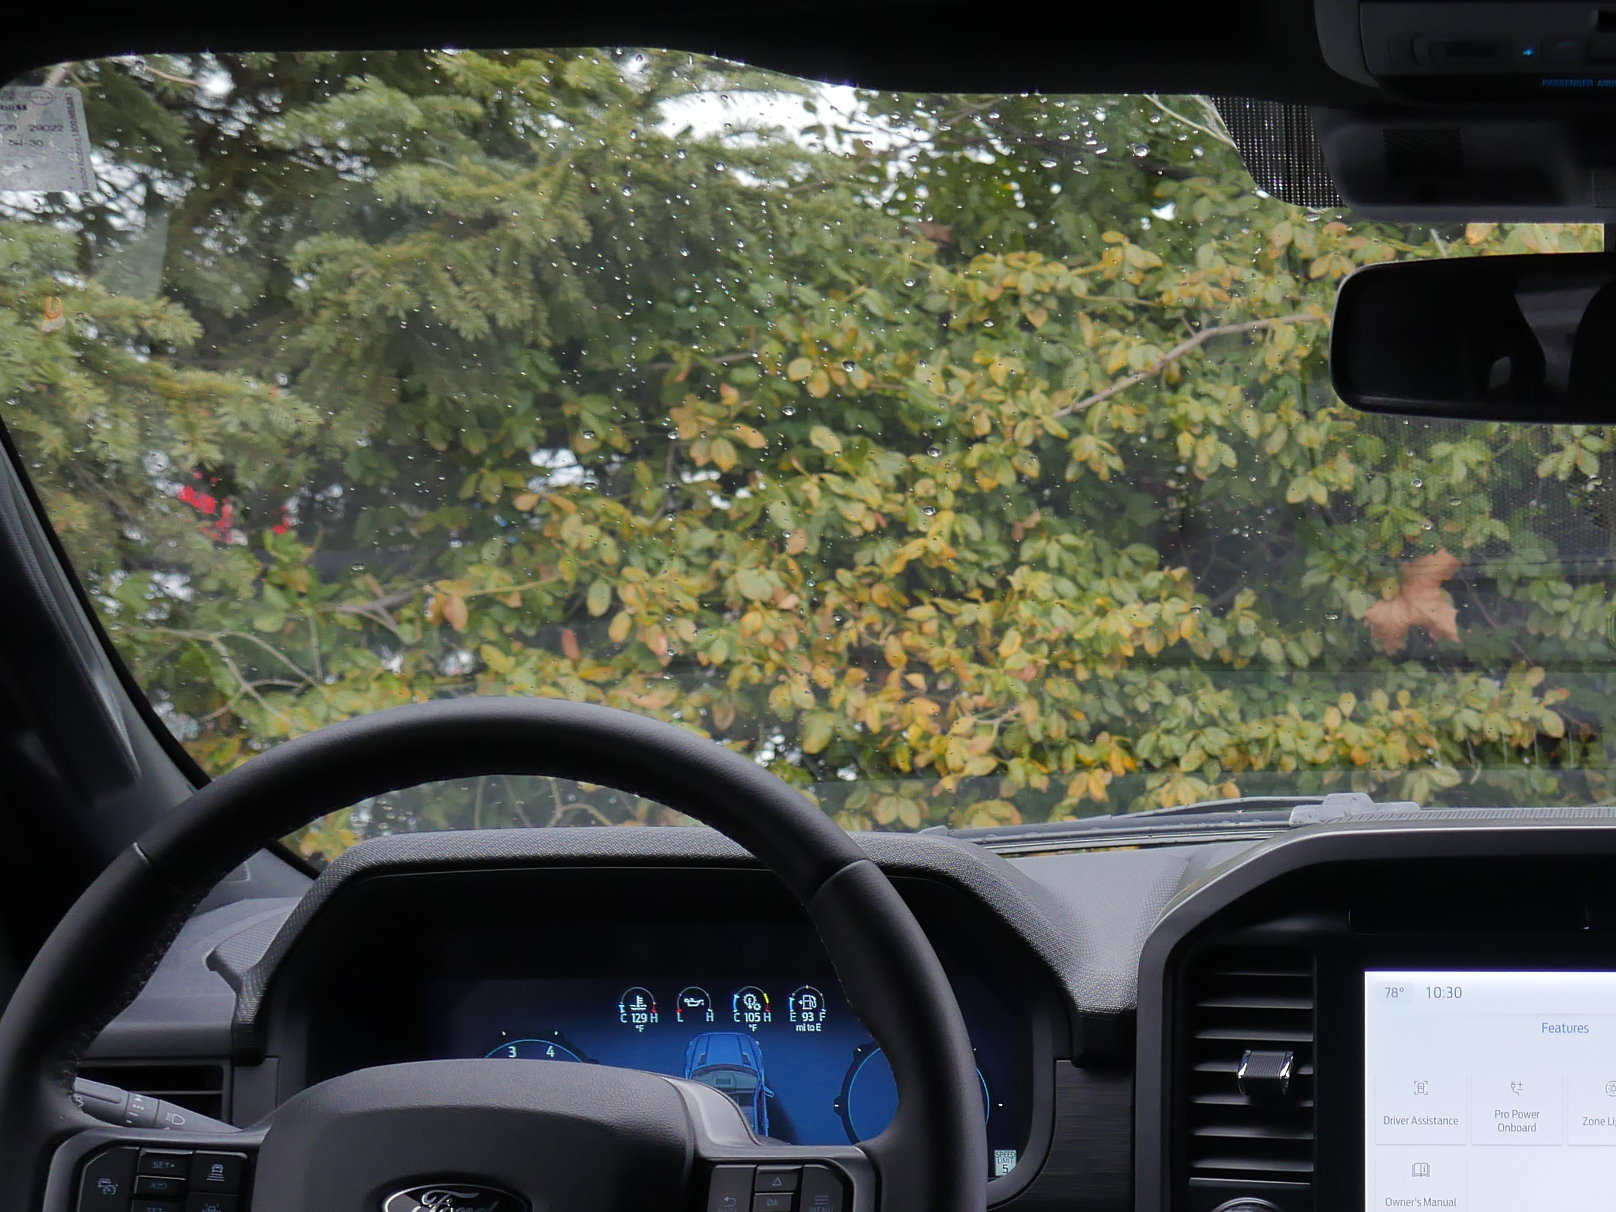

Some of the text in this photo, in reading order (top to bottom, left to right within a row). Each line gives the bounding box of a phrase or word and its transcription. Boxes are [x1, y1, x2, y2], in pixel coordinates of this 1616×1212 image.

[1385, 986, 1405, 998] 78°
[1425, 986, 1463, 999] 10:30
[631, 1013, 647, 1023] 129
[650, 1013, 659, 1023] H
[705, 1013, 714, 1022] H
[744, 1013, 760, 1023] 105
[763, 1013, 772, 1023] H
[802, 1013, 814, 1023] 93
[1541, 1022, 1590, 1034] Features
[508, 1045, 517, 1058] 3
[546, 1045, 555, 1058] 4
[1494, 1109, 1540, 1119] Pro Power
[1383, 1116, 1459, 1126] Driver Assistance
[1582, 1116, 1606, 1126] Zone
[1497, 1123, 1537, 1133] Onboard
[1385, 1197, 1457, 1208] Owner's Manual
